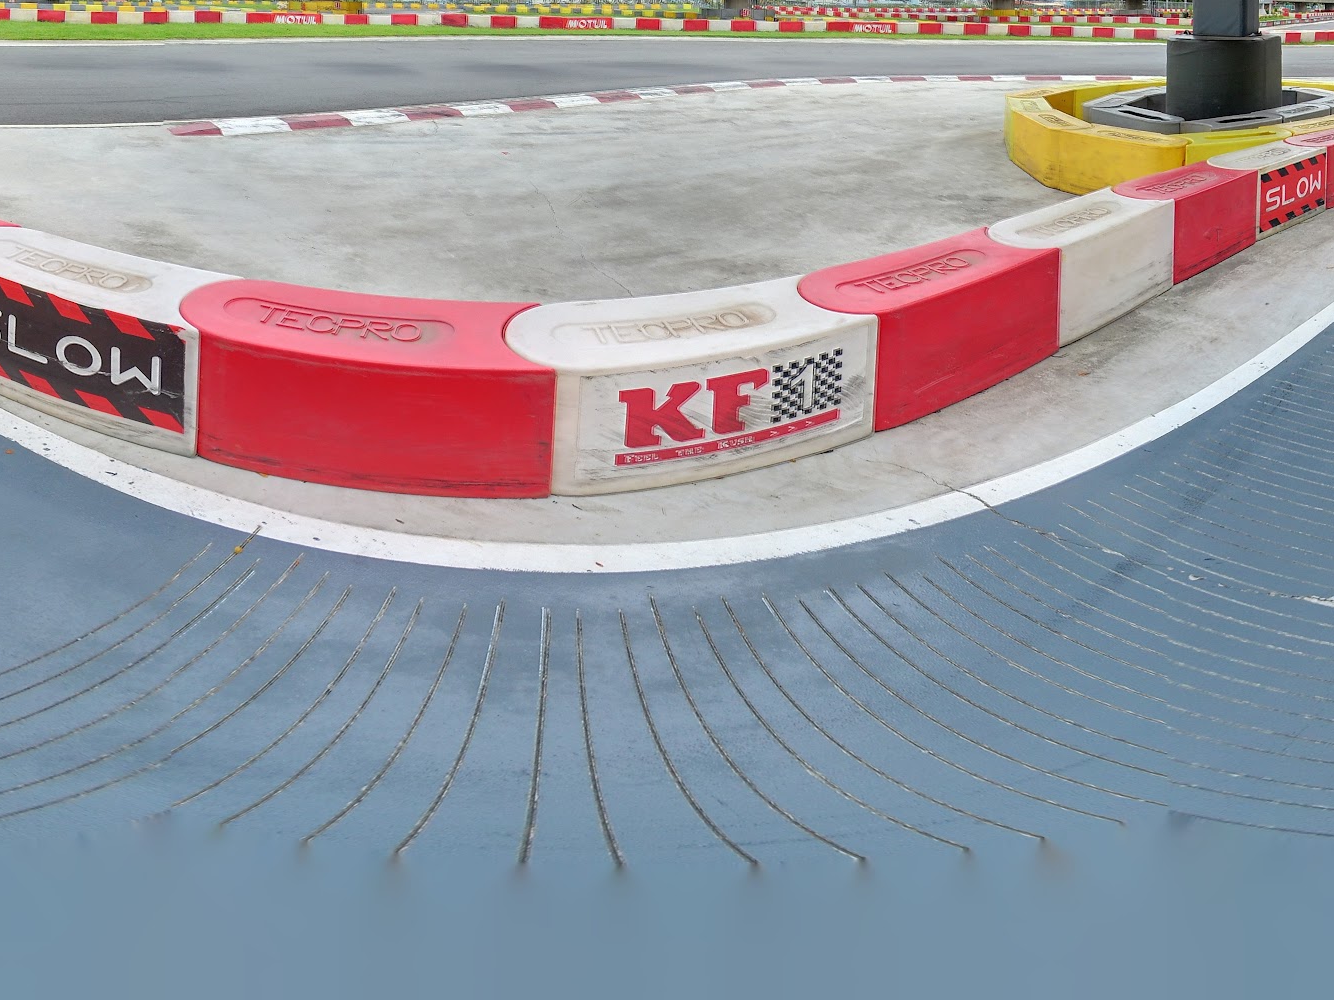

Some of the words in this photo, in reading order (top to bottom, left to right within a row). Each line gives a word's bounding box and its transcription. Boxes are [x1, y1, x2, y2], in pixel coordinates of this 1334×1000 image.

[274, 15, 317, 25] MOTUL
[566, 18, 608, 29] MOTUL
[852, 23, 893, 33] MOTUL
[1265, 170, 1322, 213] SLOW
[6, 246, 129, 290] TECPRO
[854, 256, 971, 294] TECPRO
[259, 304, 422, 342] TECPRO
[581, 310, 750, 345] TECPRO
